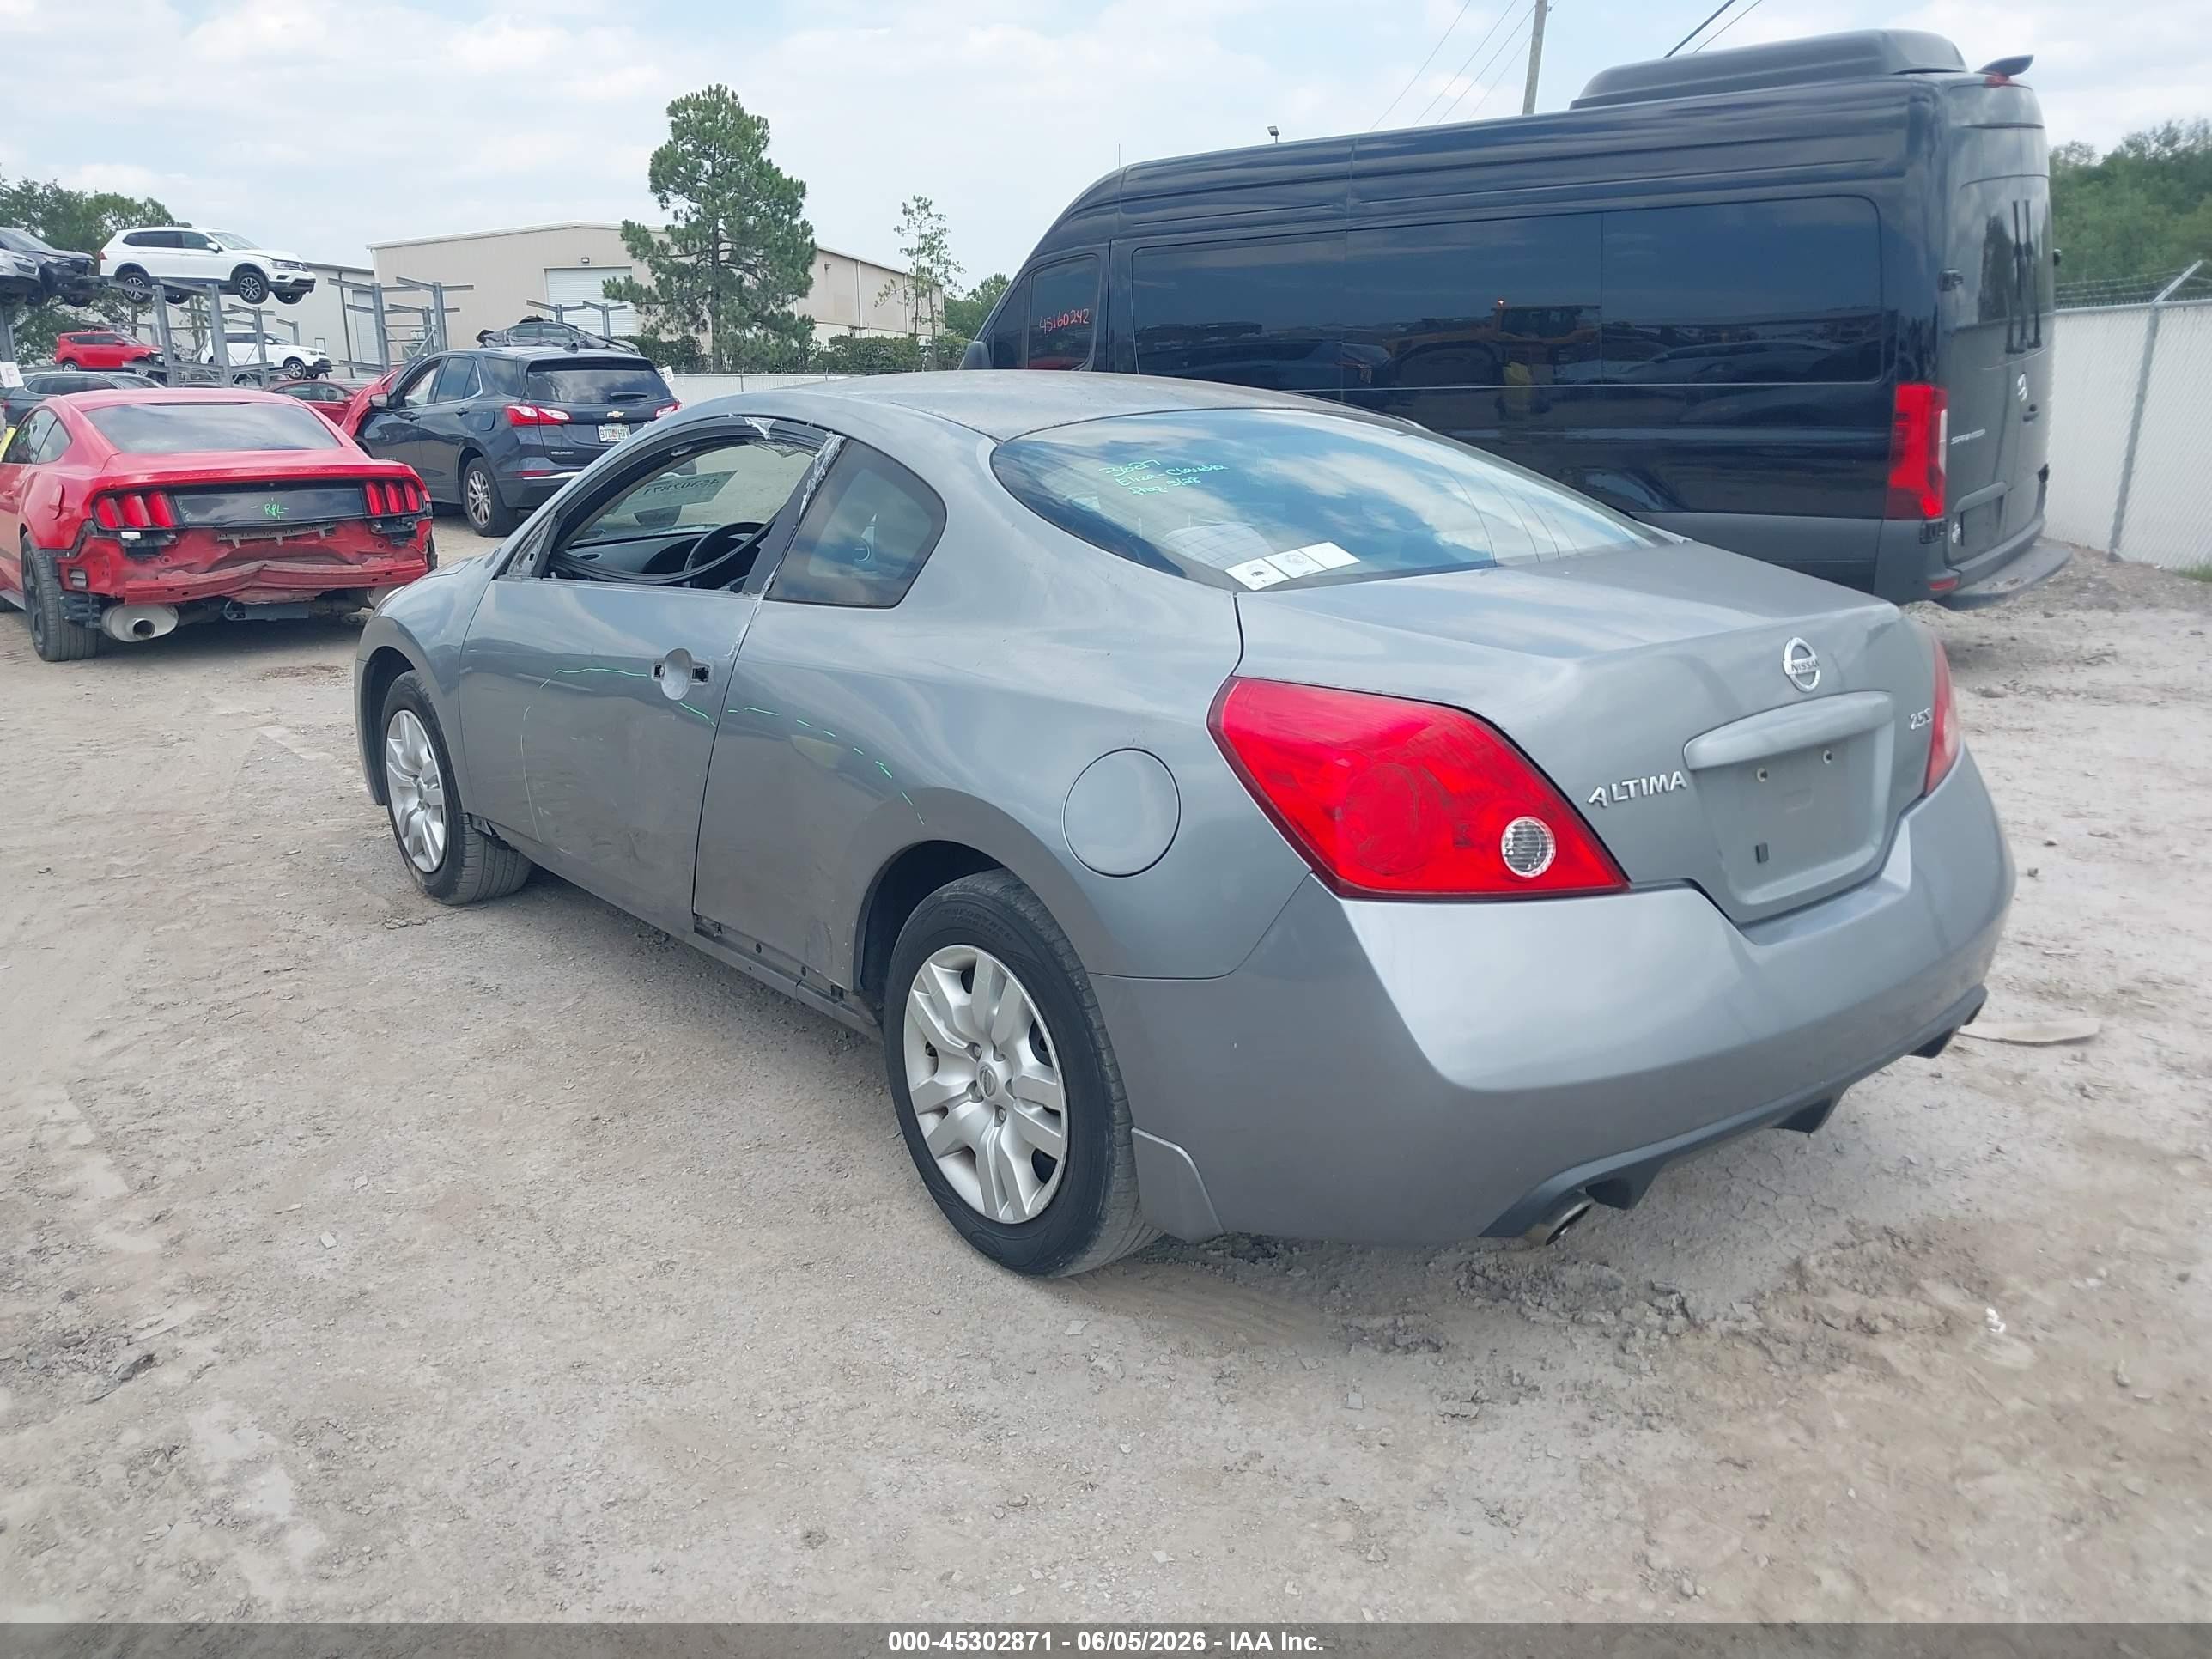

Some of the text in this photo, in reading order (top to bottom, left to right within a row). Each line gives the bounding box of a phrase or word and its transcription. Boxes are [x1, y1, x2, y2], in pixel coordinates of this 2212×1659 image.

[1039, 308, 1090, 335] 45160242
[1791, 658, 1820, 674] NISSAN
[1587, 770, 1687, 807] ALTIMA
